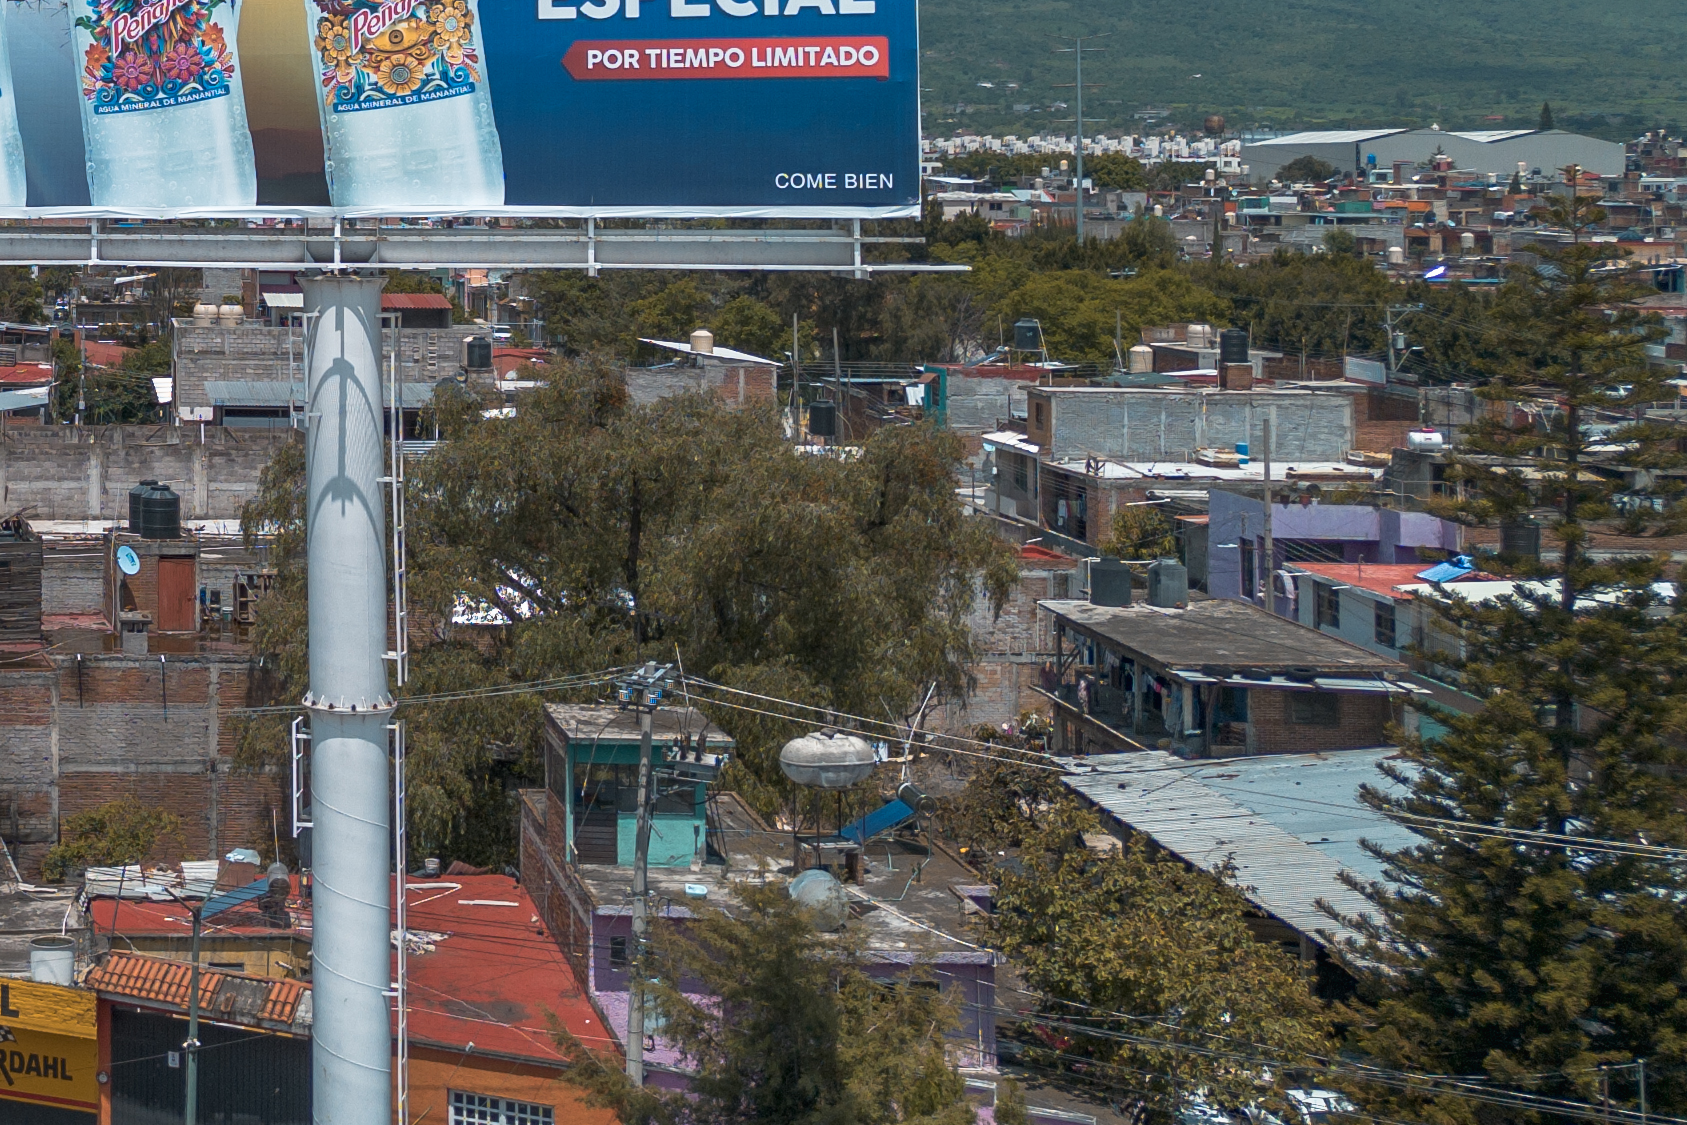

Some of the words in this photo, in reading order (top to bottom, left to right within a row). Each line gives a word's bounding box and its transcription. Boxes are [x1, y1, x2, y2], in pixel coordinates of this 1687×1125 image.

[587, 49, 640, 69] POR
[644, 47, 745, 69] TIEMPO
[752, 46, 880, 68] LIMITADO
[98, 105, 120, 114] AGUA
[121, 100, 161, 112] MINERAL
[163, 97, 176, 106] DE
[178, 88, 227, 104] MANANTIAL
[337, 102, 360, 111] AGUA
[361, 97, 404, 109] MINERAL
[405, 94, 419, 103] DE
[421, 85, 472, 101] MANANTIAL
[775, 173, 837, 189] COME
[844, 173, 893, 189] BIEN
